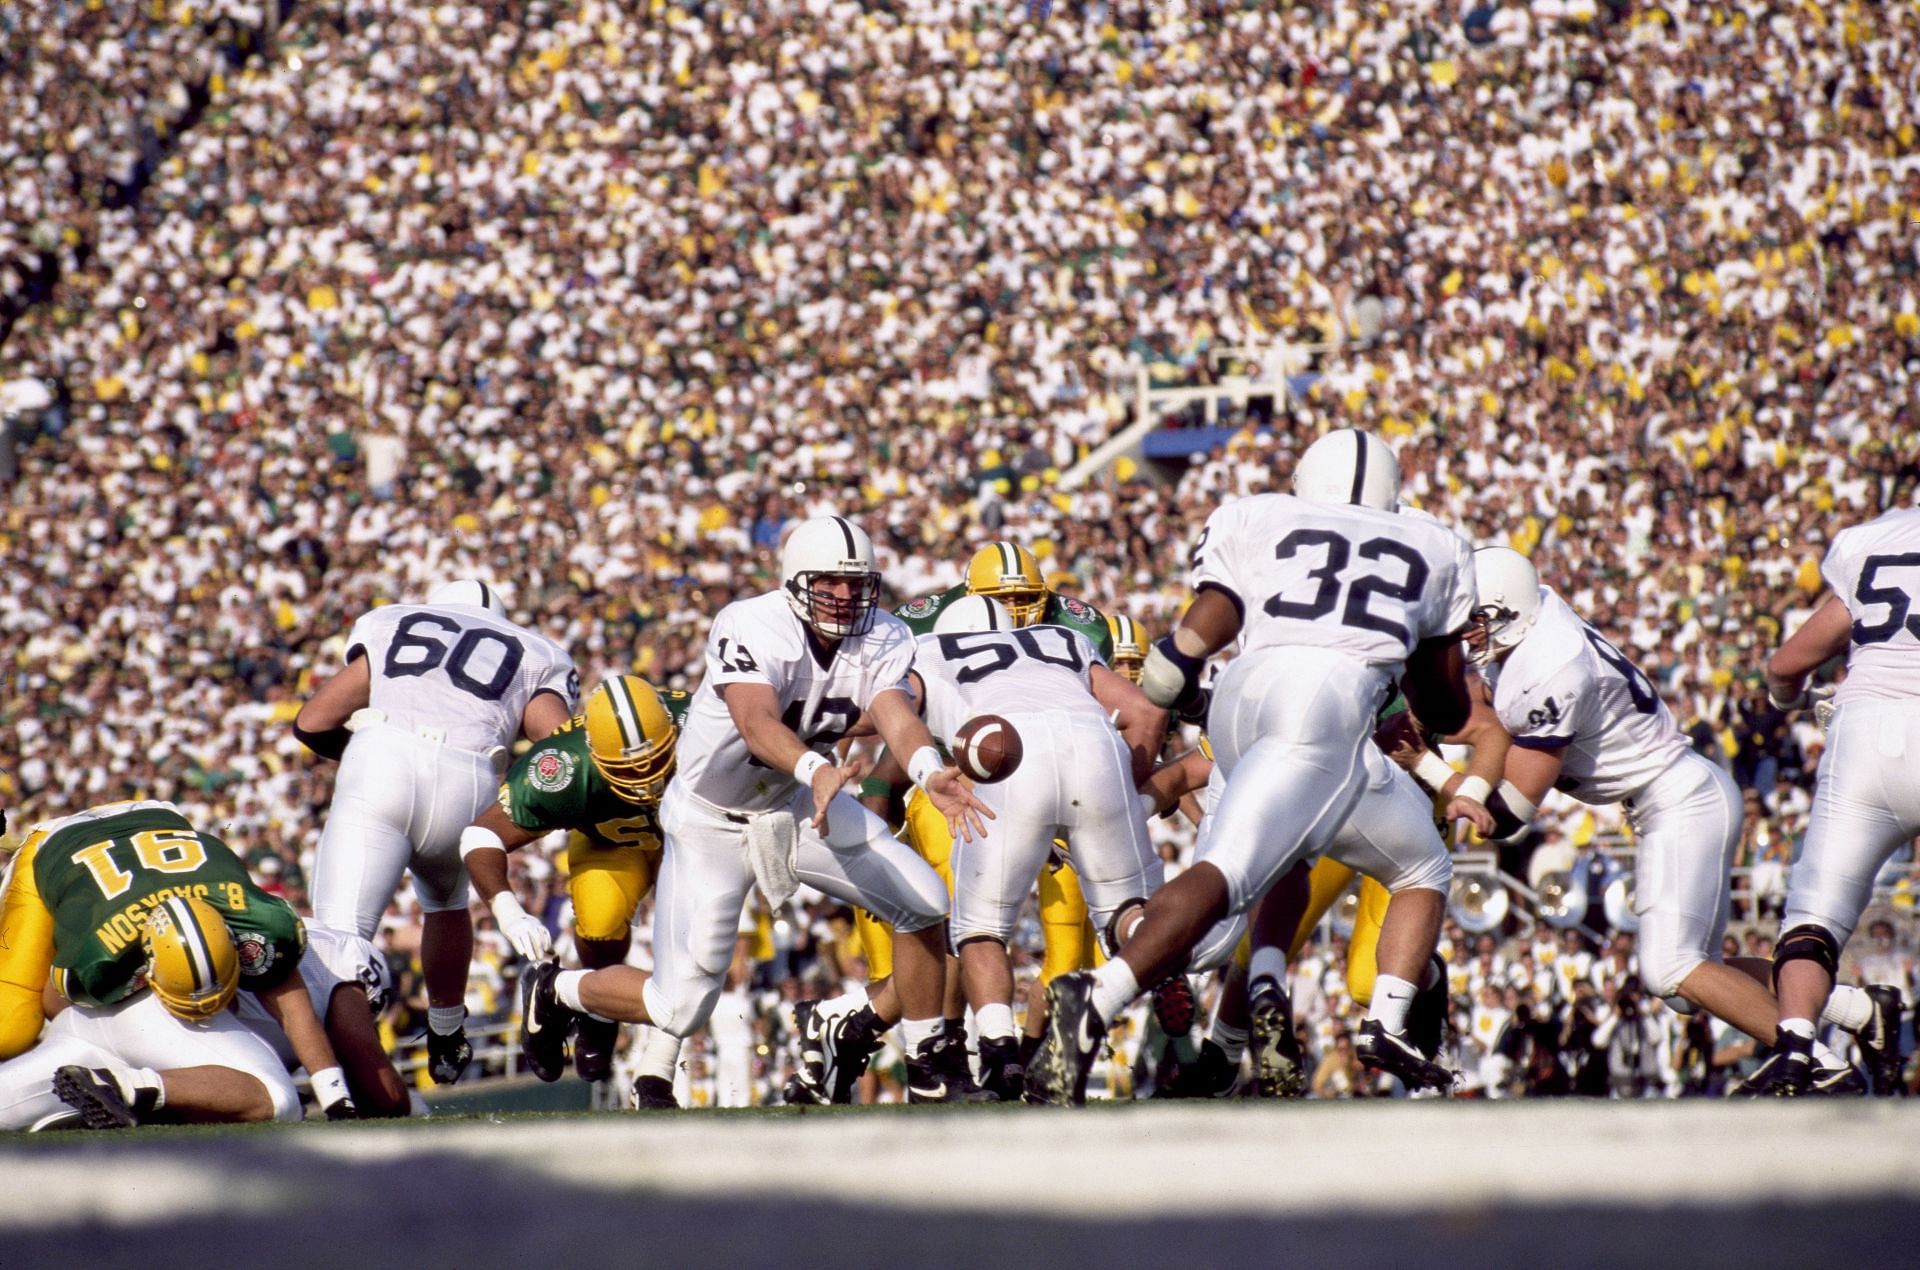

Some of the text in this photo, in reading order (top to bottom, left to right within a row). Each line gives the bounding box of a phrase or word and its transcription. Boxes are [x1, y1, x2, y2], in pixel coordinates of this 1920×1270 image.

[1263, 529, 1430, 650] 32
[1852, 552, 1920, 646] 5
[383, 612, 525, 701] 60
[937, 624, 1083, 684] 50
[71, 829, 208, 900] 91
[219, 882, 248, 911] B.
